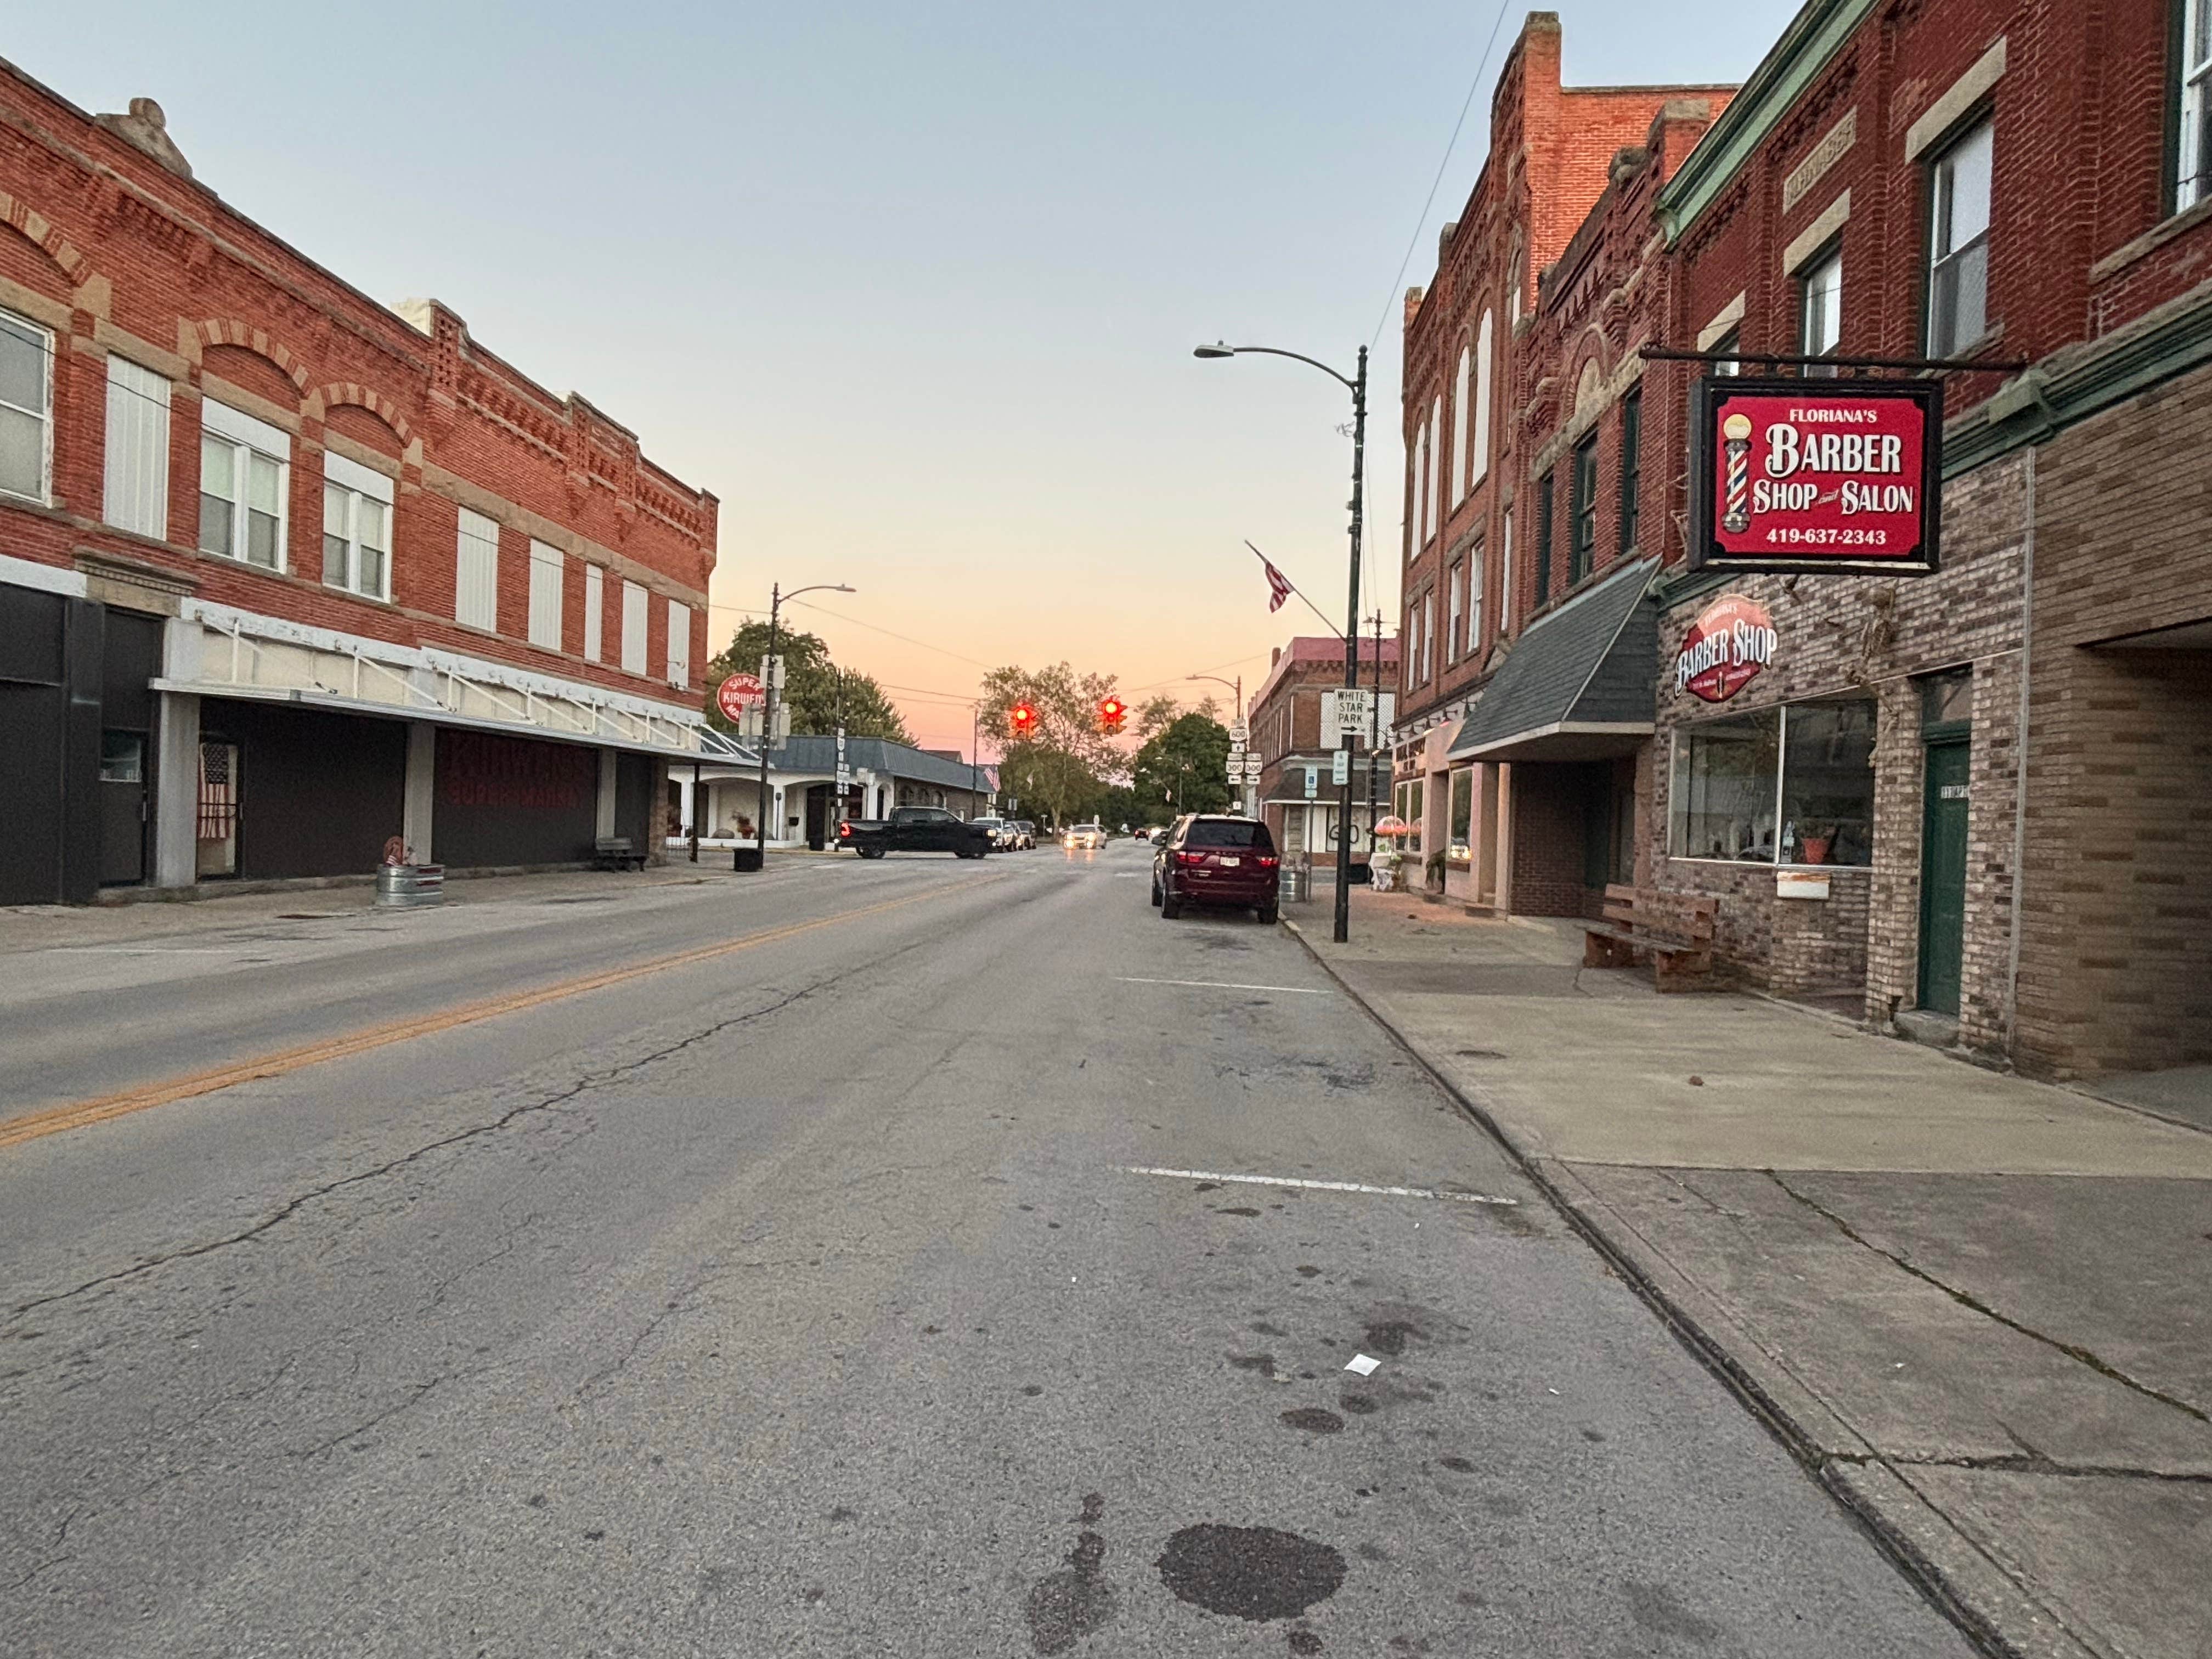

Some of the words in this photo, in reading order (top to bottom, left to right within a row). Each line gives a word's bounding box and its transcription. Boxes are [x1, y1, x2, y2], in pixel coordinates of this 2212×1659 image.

[1790, 409, 1877, 423] FLORIANA'S
[1765, 423, 1901, 478] BARBER
[1753, 479, 1818, 514] SHOP
[1841, 479, 1913, 515] SALON
[1766, 528, 1886, 545] 419-637-2343
[1674, 628, 1729, 697] BARBER
[1733, 619, 1778, 667] SHOP
[1338, 691, 1367, 702] WHITE
[1339, 702, 1363, 713] STAR
[1338, 713, 1363, 724] PARK
